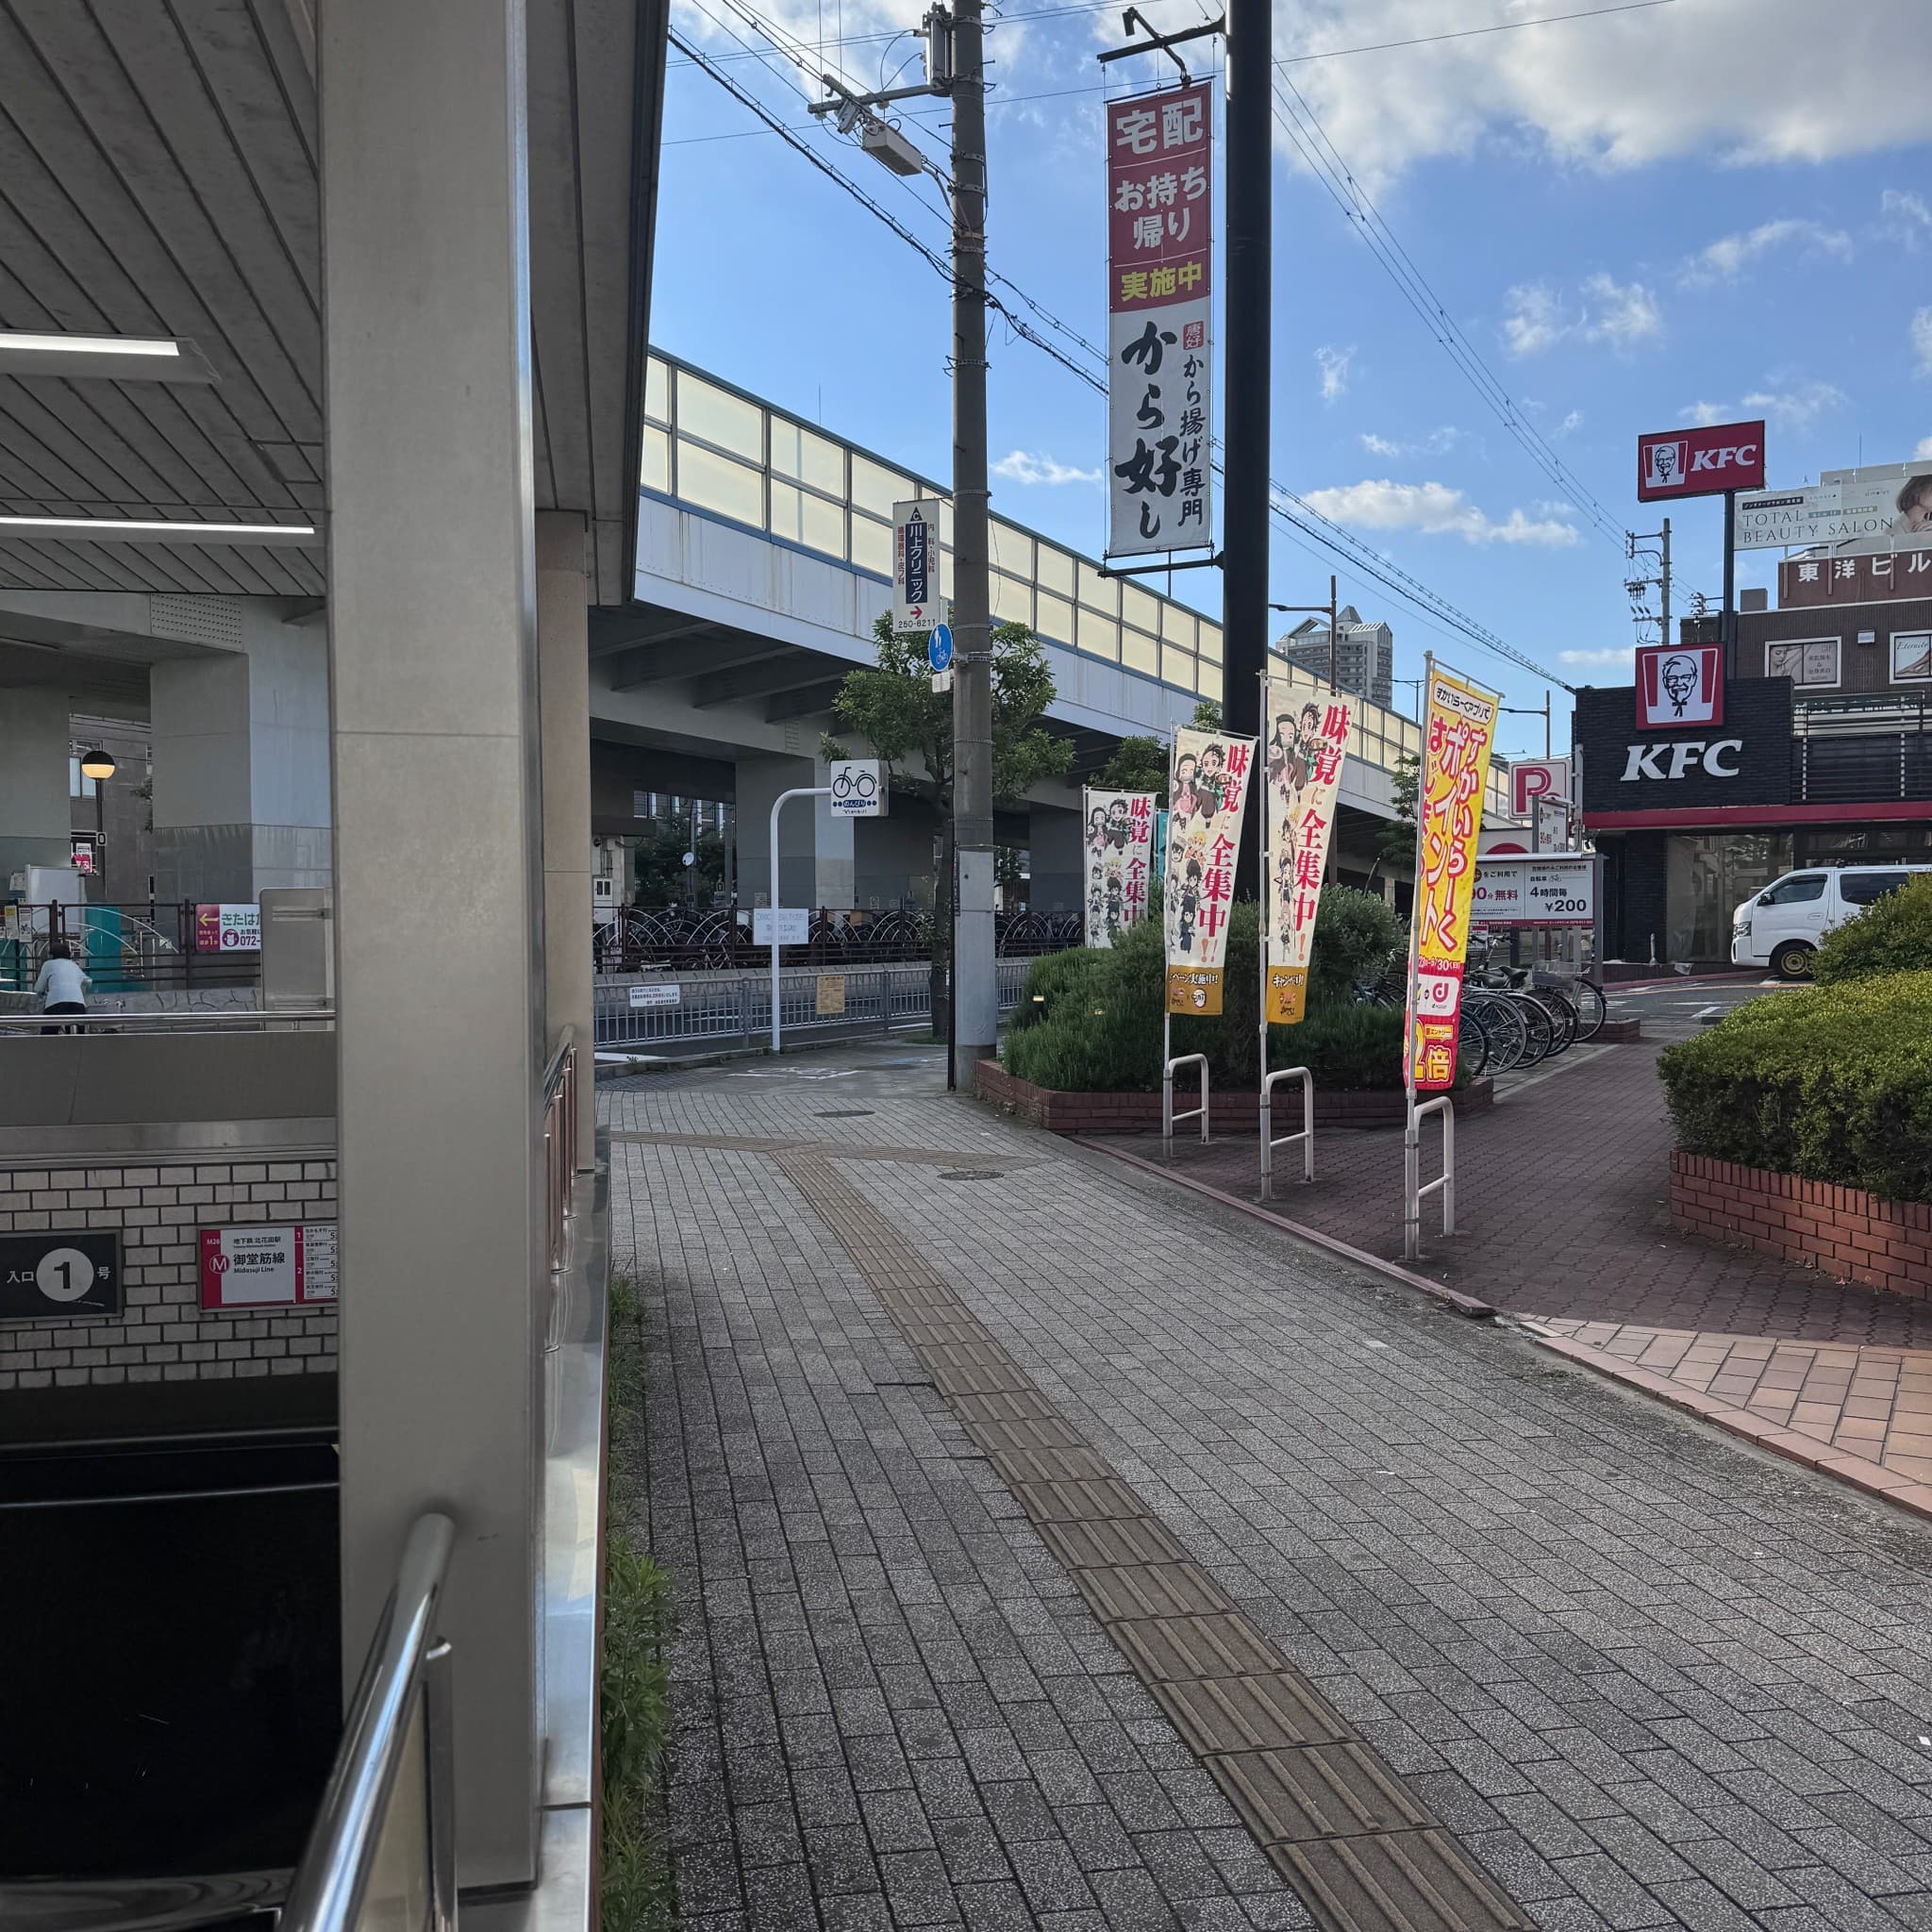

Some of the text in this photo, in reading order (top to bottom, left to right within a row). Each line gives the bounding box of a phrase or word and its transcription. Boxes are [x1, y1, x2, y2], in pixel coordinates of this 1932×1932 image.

[1116, 96, 1203, 155] 宅配
[1114, 165, 1208, 212] お持ち
[1133, 207, 1191, 250] 帰り
[1121, 260, 1203, 302] 実施中
[1114, 321, 1182, 539] から好し
[1177, 354, 1206, 526] から揚げ専門
[1690, 444, 1757, 473] KFC
[1742, 509, 1804, 527] TOTAL
[1743, 517, 1892, 543] BEAUTY SALON
[909, 524, 924, 604] 川上クリニック
[1797, 552, 1931, 584] 東洋ビル
[1620, 740, 1742, 782] KFC
[1515, 766, 1552, 813] P
[1437, 729, 1488, 953] すかいらーく
[1545, 898, 1587, 912] ¥200
[233, 1253, 286, 1266] 御堂筋線
